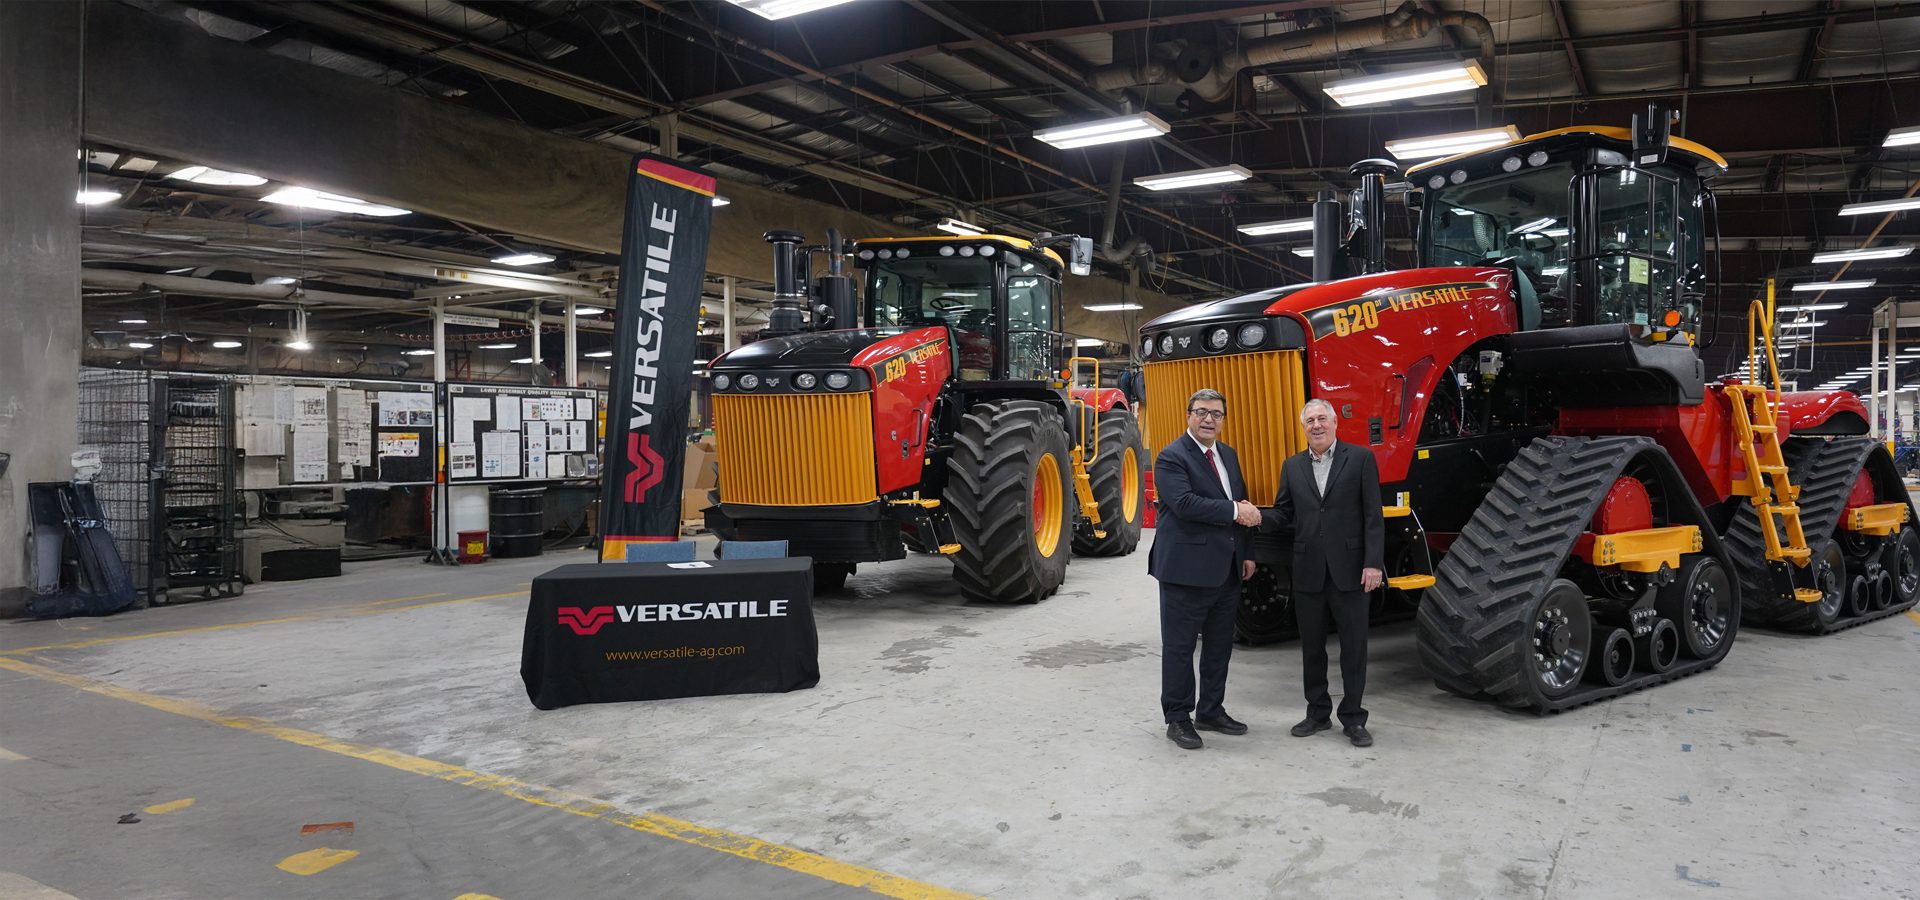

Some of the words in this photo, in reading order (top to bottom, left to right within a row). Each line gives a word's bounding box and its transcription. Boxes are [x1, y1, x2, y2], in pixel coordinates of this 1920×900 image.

[630, 202, 677, 430] VERSATILE
[1333, 301, 1379, 337] 620
[1388, 286, 1472, 313] VERSATILE
[885, 357, 907, 383] 620
[909, 343, 940, 364] VERSATILE
[616, 600, 789, 623] VERSATILE
[605, 644, 745, 661] www.versatile-ag.com
